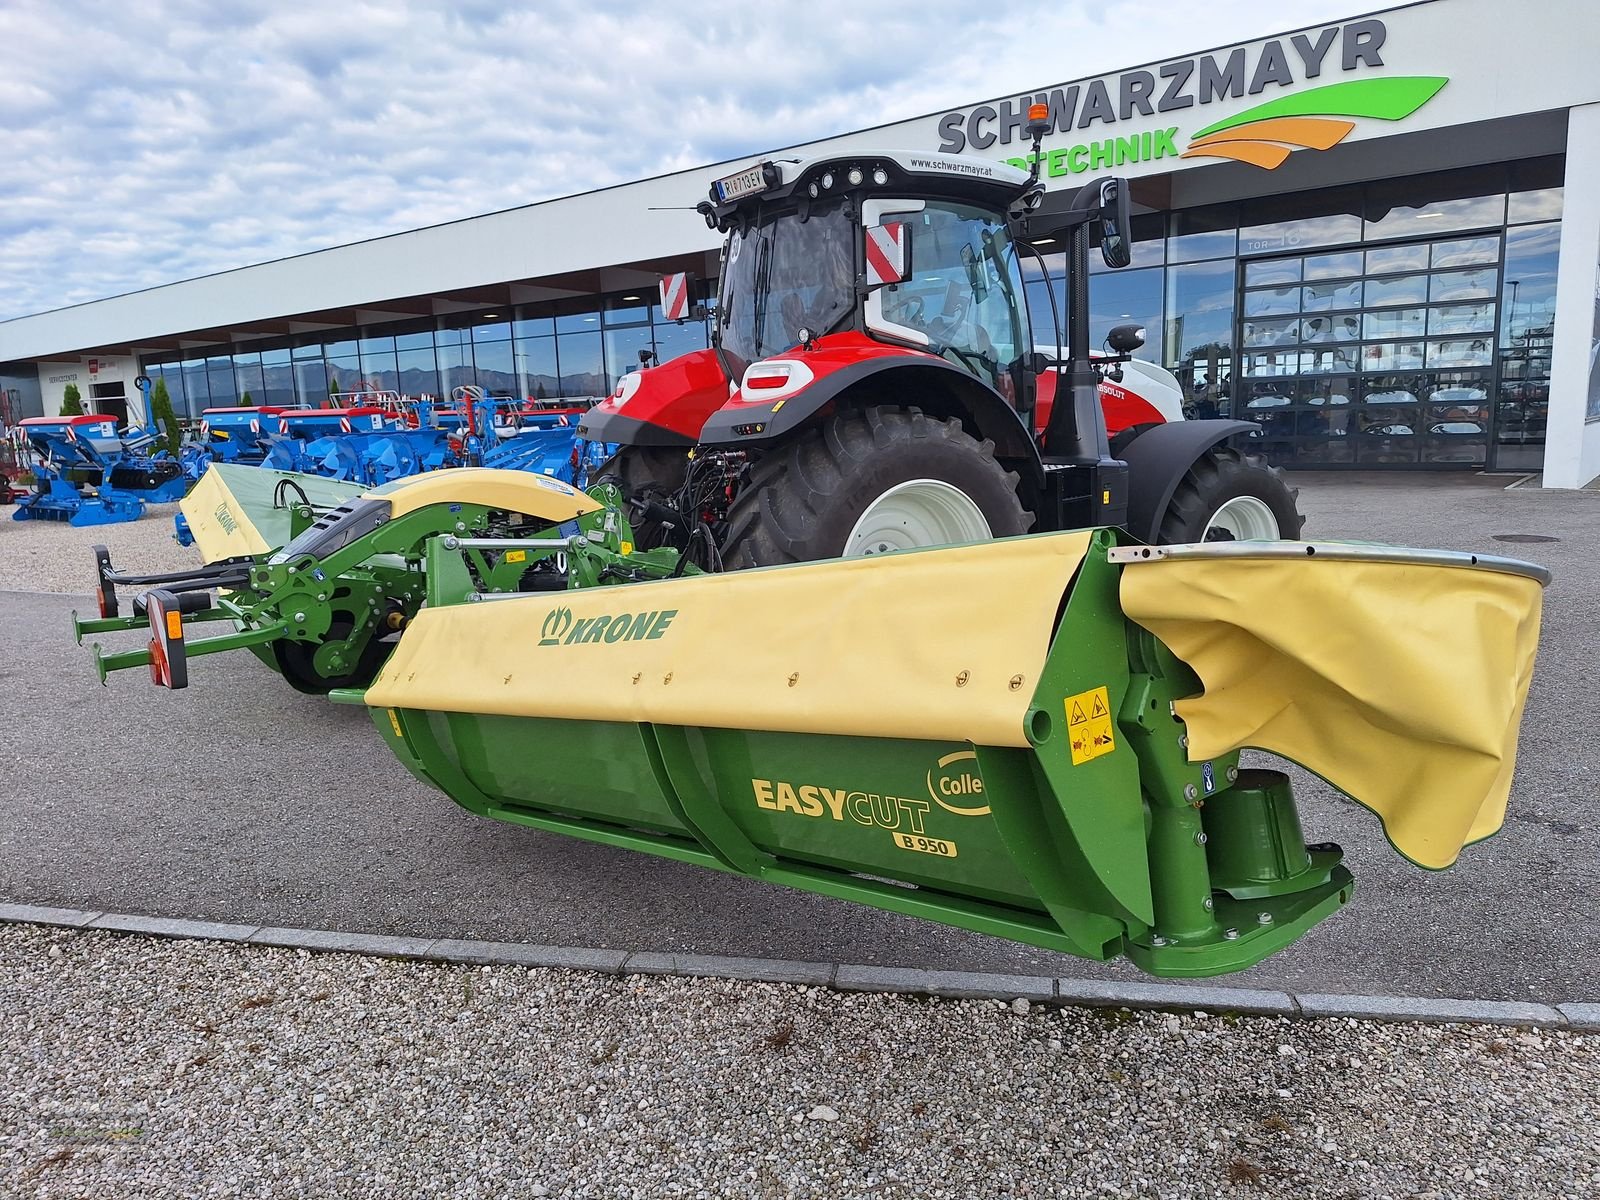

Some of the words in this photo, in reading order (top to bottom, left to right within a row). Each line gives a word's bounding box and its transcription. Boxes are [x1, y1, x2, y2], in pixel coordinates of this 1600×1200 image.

[938, 19, 1387, 154] SCHWARZMAYR
[910, 158, 993, 177] www.schwarzmayr.at
[1247, 240, 1269, 250] TOR
[217, 510, 238, 537] KRONE
[563, 609, 679, 646] KRONE
[751, 778, 931, 835] EASYCUT
[901, 835, 915, 849] B
[917, 838, 949, 855] 950
